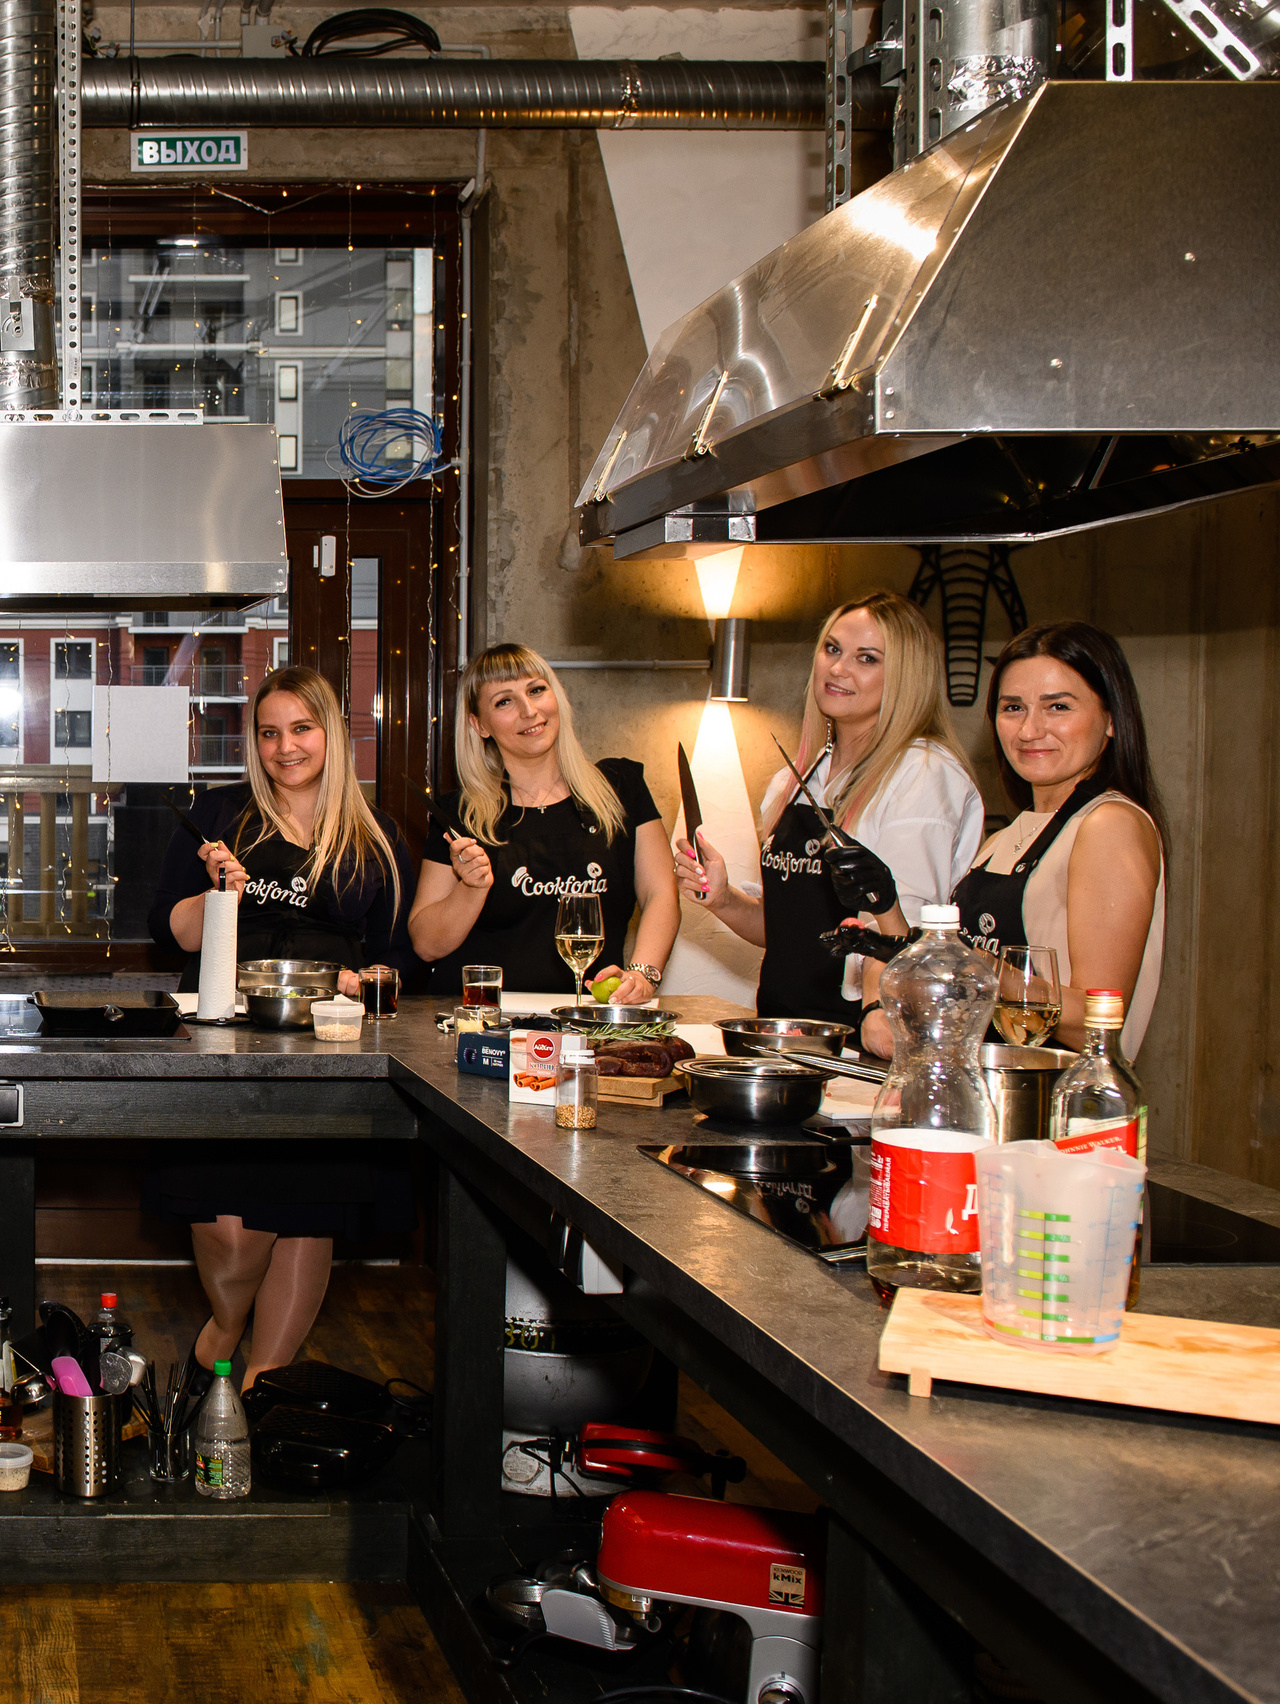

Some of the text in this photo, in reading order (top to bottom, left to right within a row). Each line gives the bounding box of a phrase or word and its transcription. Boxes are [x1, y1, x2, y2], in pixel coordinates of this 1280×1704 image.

[142, 140, 237, 164] ВЫХОД
[761, 839, 823, 882] Cookforia
[243, 877, 309, 908] okforia
[521, 866, 608, 904] Cookforia
[1060, 1144, 1088, 1154] OHNNIE
[773, 1567, 803, 1576] KENWOOD
[773, 1573, 802, 1584] kMix
